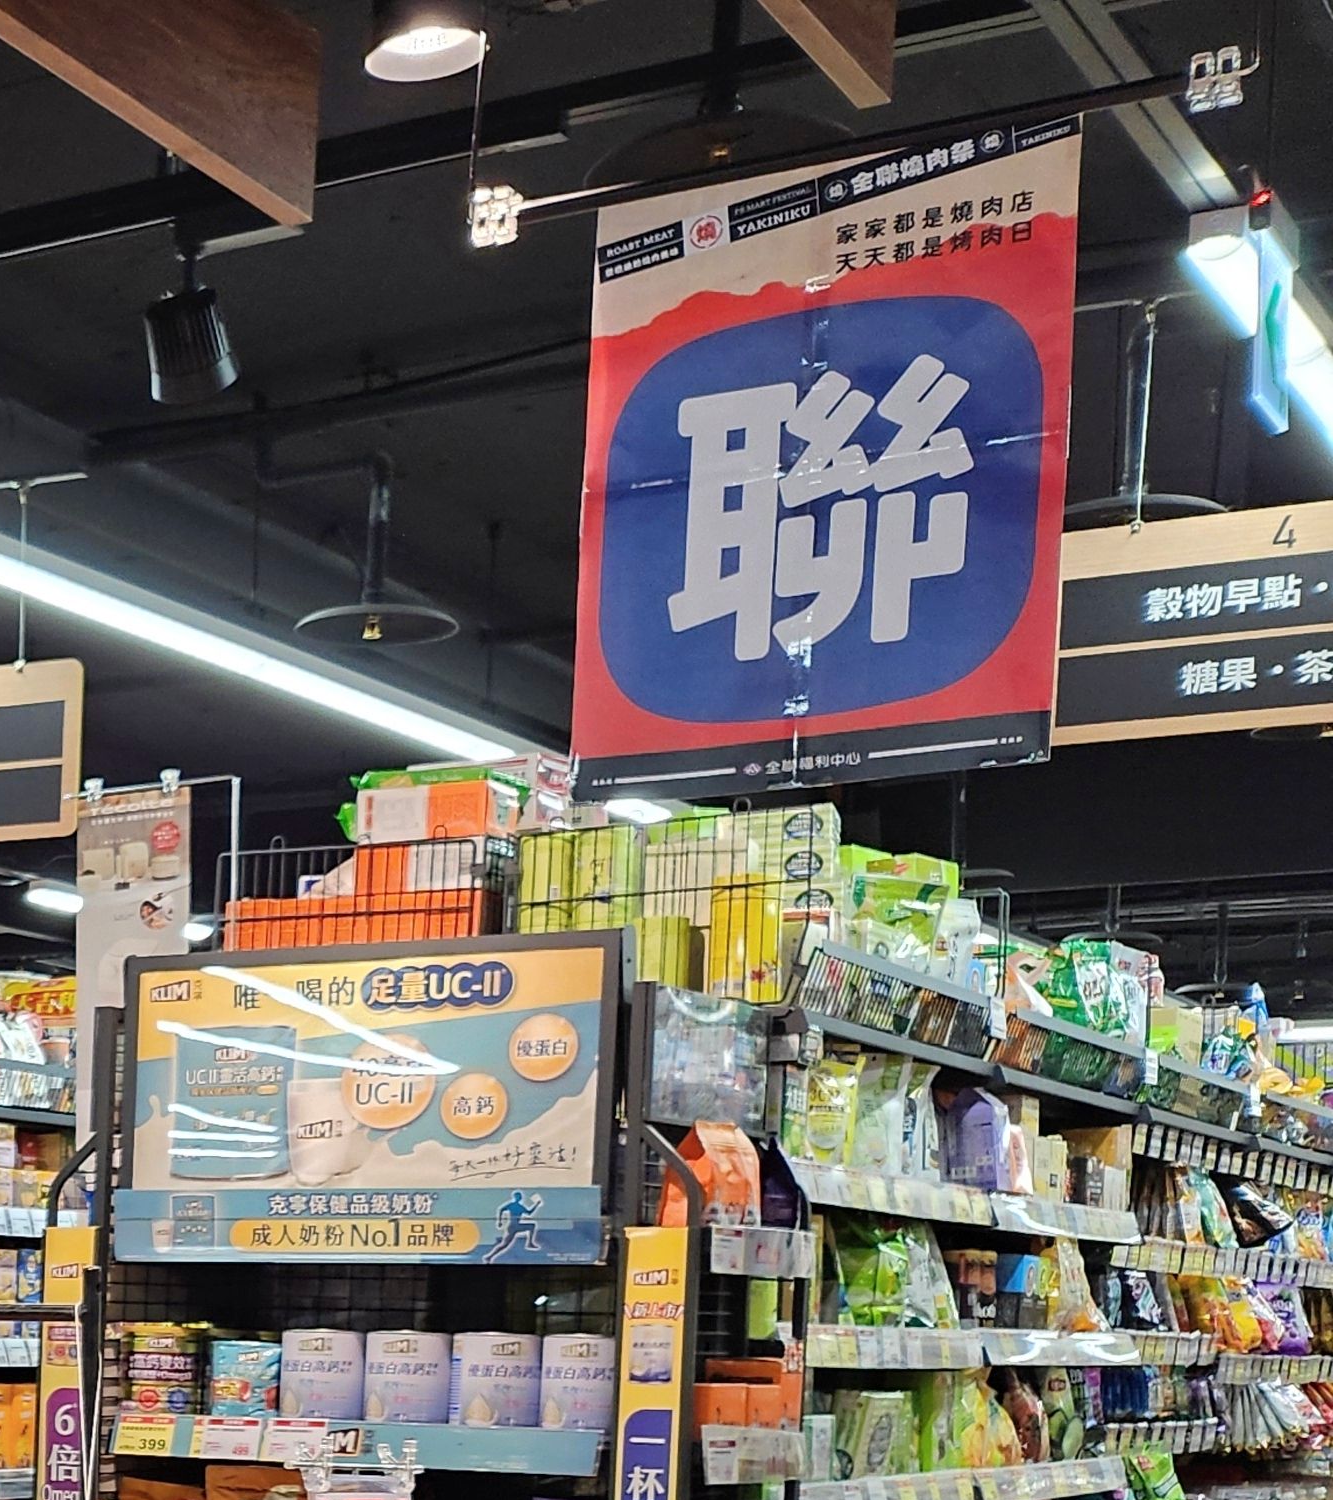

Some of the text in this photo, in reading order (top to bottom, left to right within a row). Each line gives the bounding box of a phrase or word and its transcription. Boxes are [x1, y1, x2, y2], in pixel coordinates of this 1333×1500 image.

[850, 138, 976, 196] 全聯燒肉祭
[736, 204, 812, 237] YAKINIKU
[836, 190, 1035, 247] 家家都是燒肉店
[607, 228, 676, 259] ROAST MEAT
[836, 221, 1034, 275] 天天都是烤肉日
[667, 354, 975, 662] 聯
[1272, 514, 1297, 549] 4
[149, 979, 192, 1005] KLIM
[233, 974, 357, 1011] 唯喝的
[353, 1080, 415, 1107] UC-II
[451, 1094, 496, 1118] 高鈣
[296, 1119, 334, 1142] KLIM
[50, 1263, 79, 1280] KLIM
[633, 1269, 668, 1287] KLIM
[138, 1438, 167, 1452] 399
